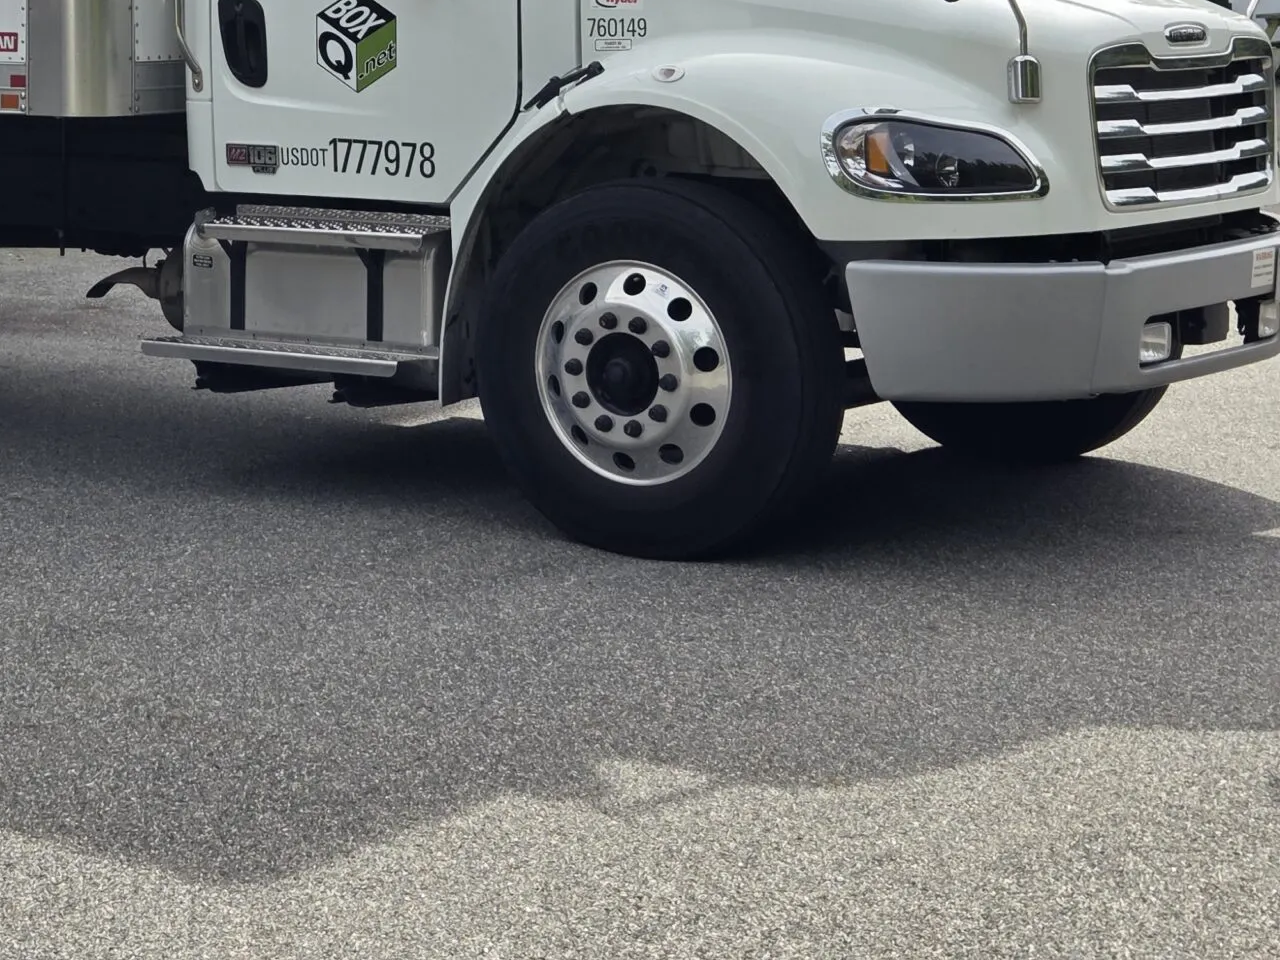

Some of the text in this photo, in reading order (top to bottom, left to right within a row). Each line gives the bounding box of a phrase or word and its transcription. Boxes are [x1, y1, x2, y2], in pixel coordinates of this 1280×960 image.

[587, 17, 647, 38] 760149
[318, 31, 354, 81] Q
[357, 40, 397, 81] .net
[229, 146, 277, 165] M2 106
[280, 138, 436, 179] USDOT 1777978
